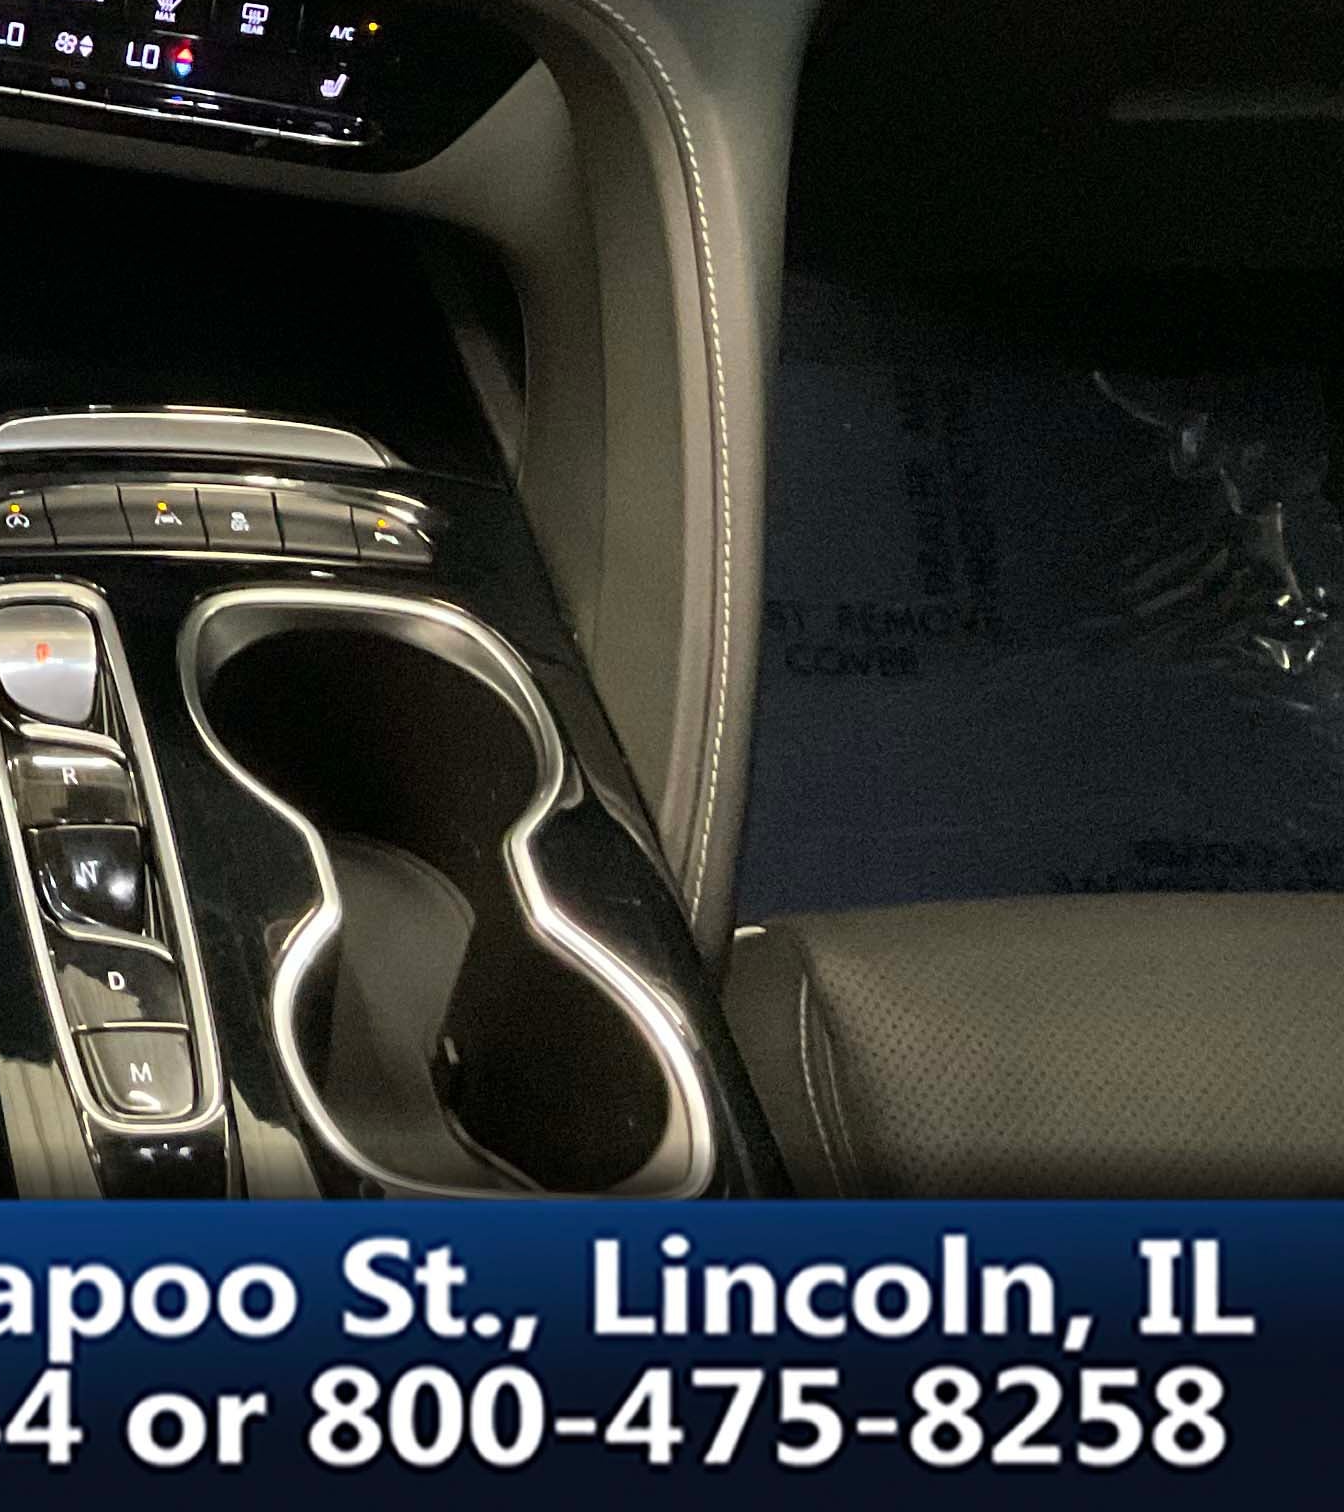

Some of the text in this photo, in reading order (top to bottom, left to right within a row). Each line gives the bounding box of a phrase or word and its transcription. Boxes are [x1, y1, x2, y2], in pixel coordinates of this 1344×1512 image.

[330, 25, 356, 41] A/C
[63, 767, 79, 786] R
[108, 971, 126, 992] D
[128, 1062, 153, 1084] M
